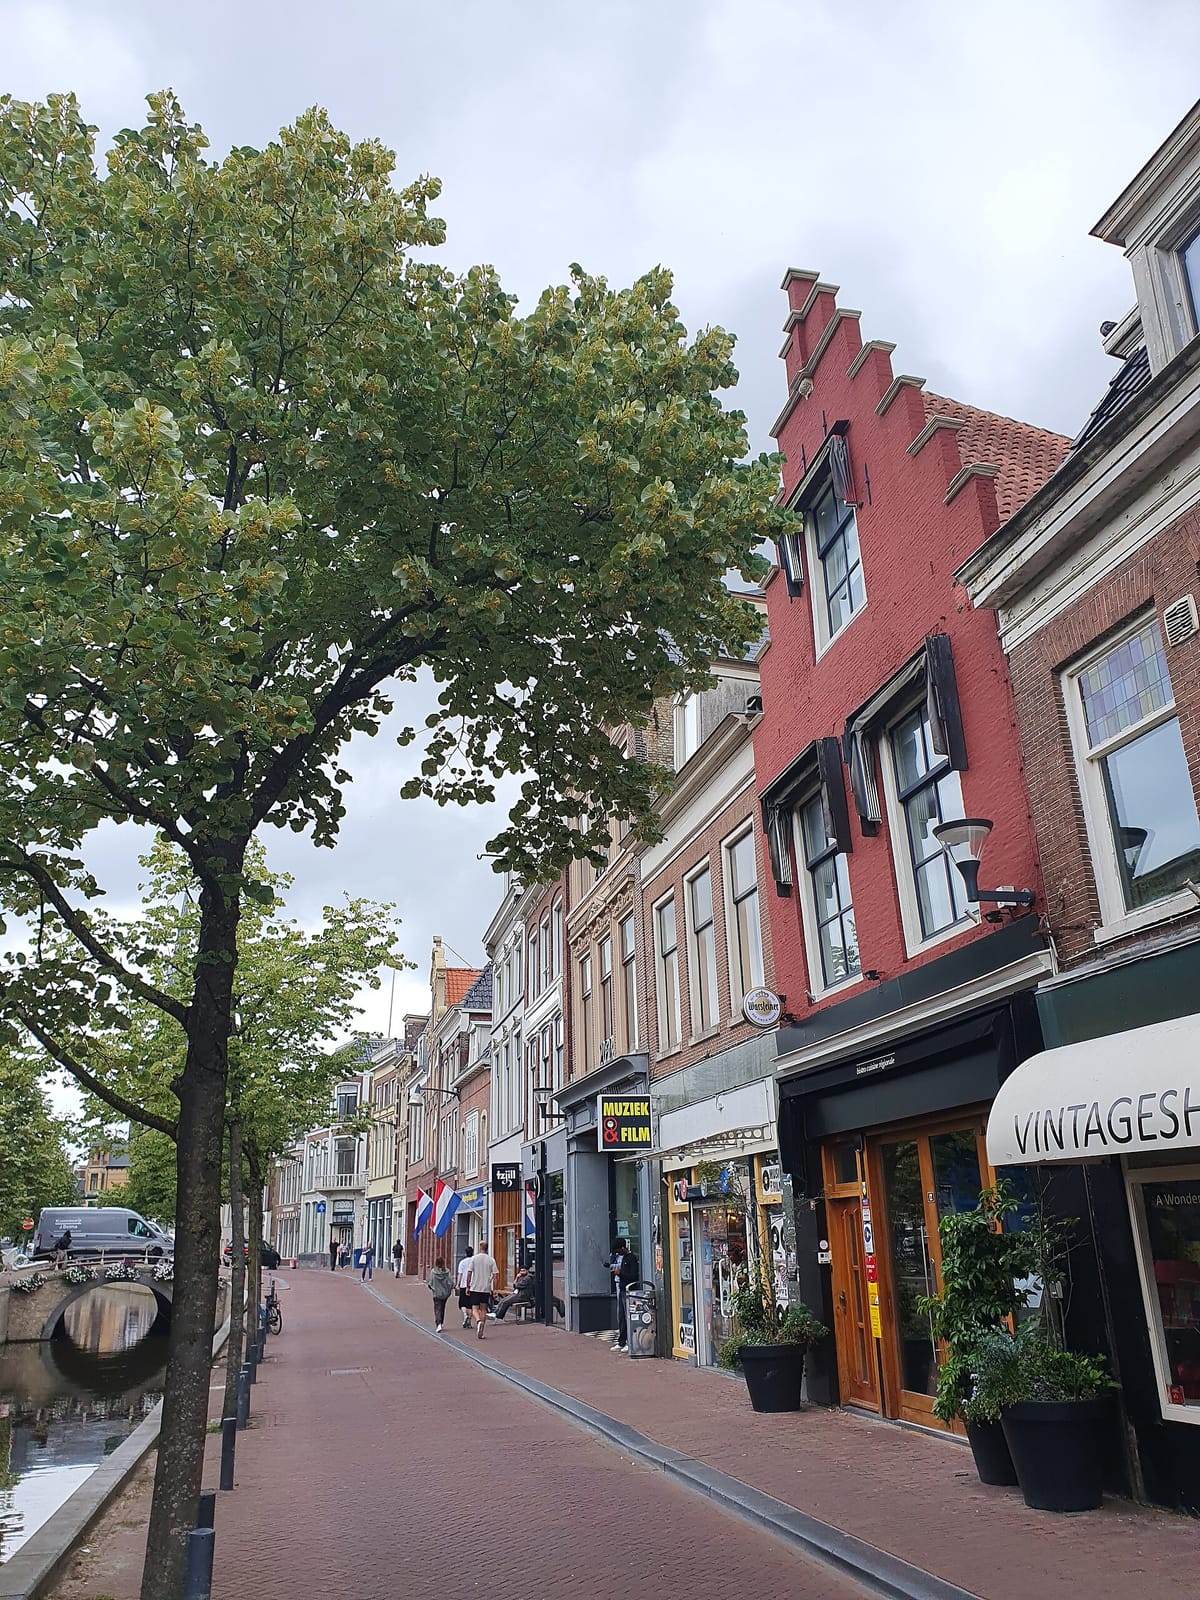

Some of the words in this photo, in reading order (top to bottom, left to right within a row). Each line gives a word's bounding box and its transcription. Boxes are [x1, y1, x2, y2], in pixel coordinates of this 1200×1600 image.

[748, 1001, 779, 1012] Warsteiner
[603, 1102, 650, 1116] MUZIEK
[621, 1127, 651, 1142] FILM
[1156, 1194, 1163, 1206] A
